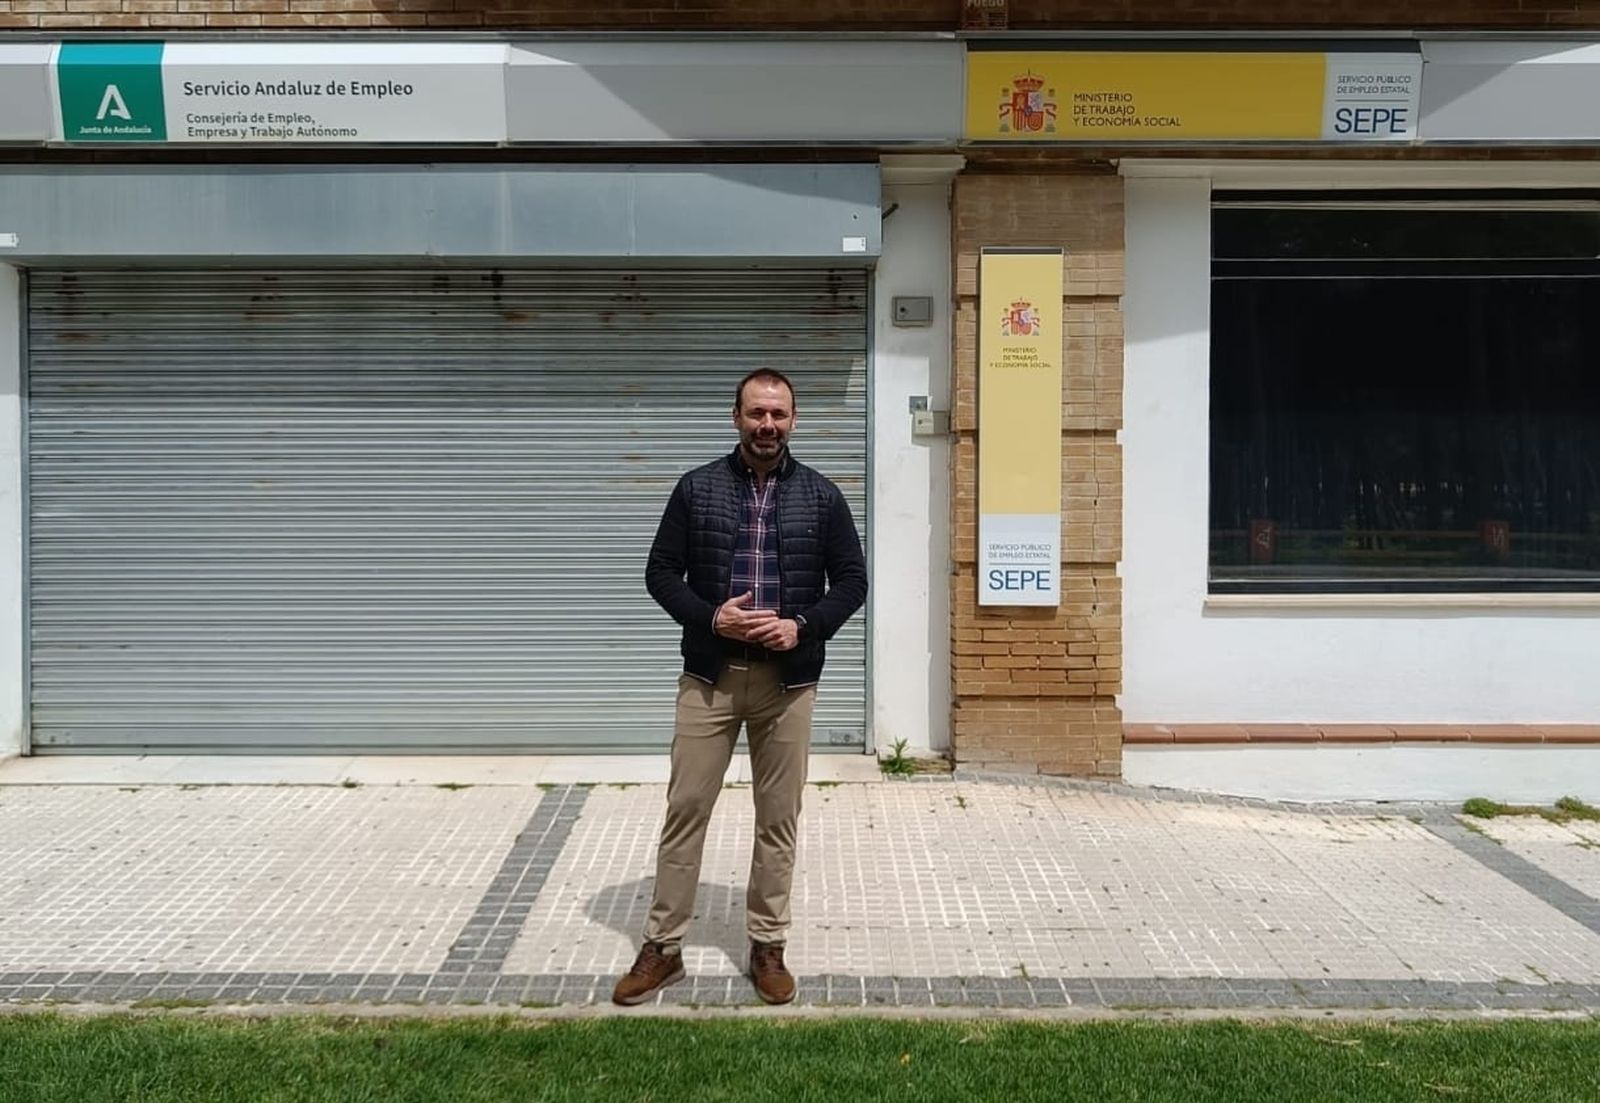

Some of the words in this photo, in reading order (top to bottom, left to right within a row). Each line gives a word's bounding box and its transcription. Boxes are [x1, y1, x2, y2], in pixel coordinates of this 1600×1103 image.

[1337, 75, 1374, 84] SERVICIO
[183, 81, 251, 96] Servicio
[255, 81, 322, 96] Andaluz
[326, 81, 346, 96] de
[351, 81, 414, 99] Empleo
[1337, 86, 1347, 94] DE
[1349, 86, 1379, 94] EMPLEO
[1381, 86, 1410, 94] ESTATAL
[1073, 93, 1133, 102] MINISTERIO
[1073, 105, 1089, 115] DE
[1090, 105, 1136, 116] TRABAJO
[186, 111, 248, 126] Consejería
[250, 113, 265, 124] de
[267, 113, 316, 126] Empleo,
[1073, 117, 1080, 127] Y
[1082, 116, 1141, 127] ECONOMÍA
[1144, 117, 1182, 127] SOCIAL
[1334, 108, 1408, 134] SEPE
[80, 126, 101, 134] Junta
[103, 126, 112, 134] de
[187, 126, 238, 139] Empresa
[241, 129, 248, 139] y
[250, 126, 294, 139] Trabajo
[296, 125, 358, 137] Autónomo
[989, 543, 1020, 551] SERVICIO
[989, 570, 1051, 590] SEPE
